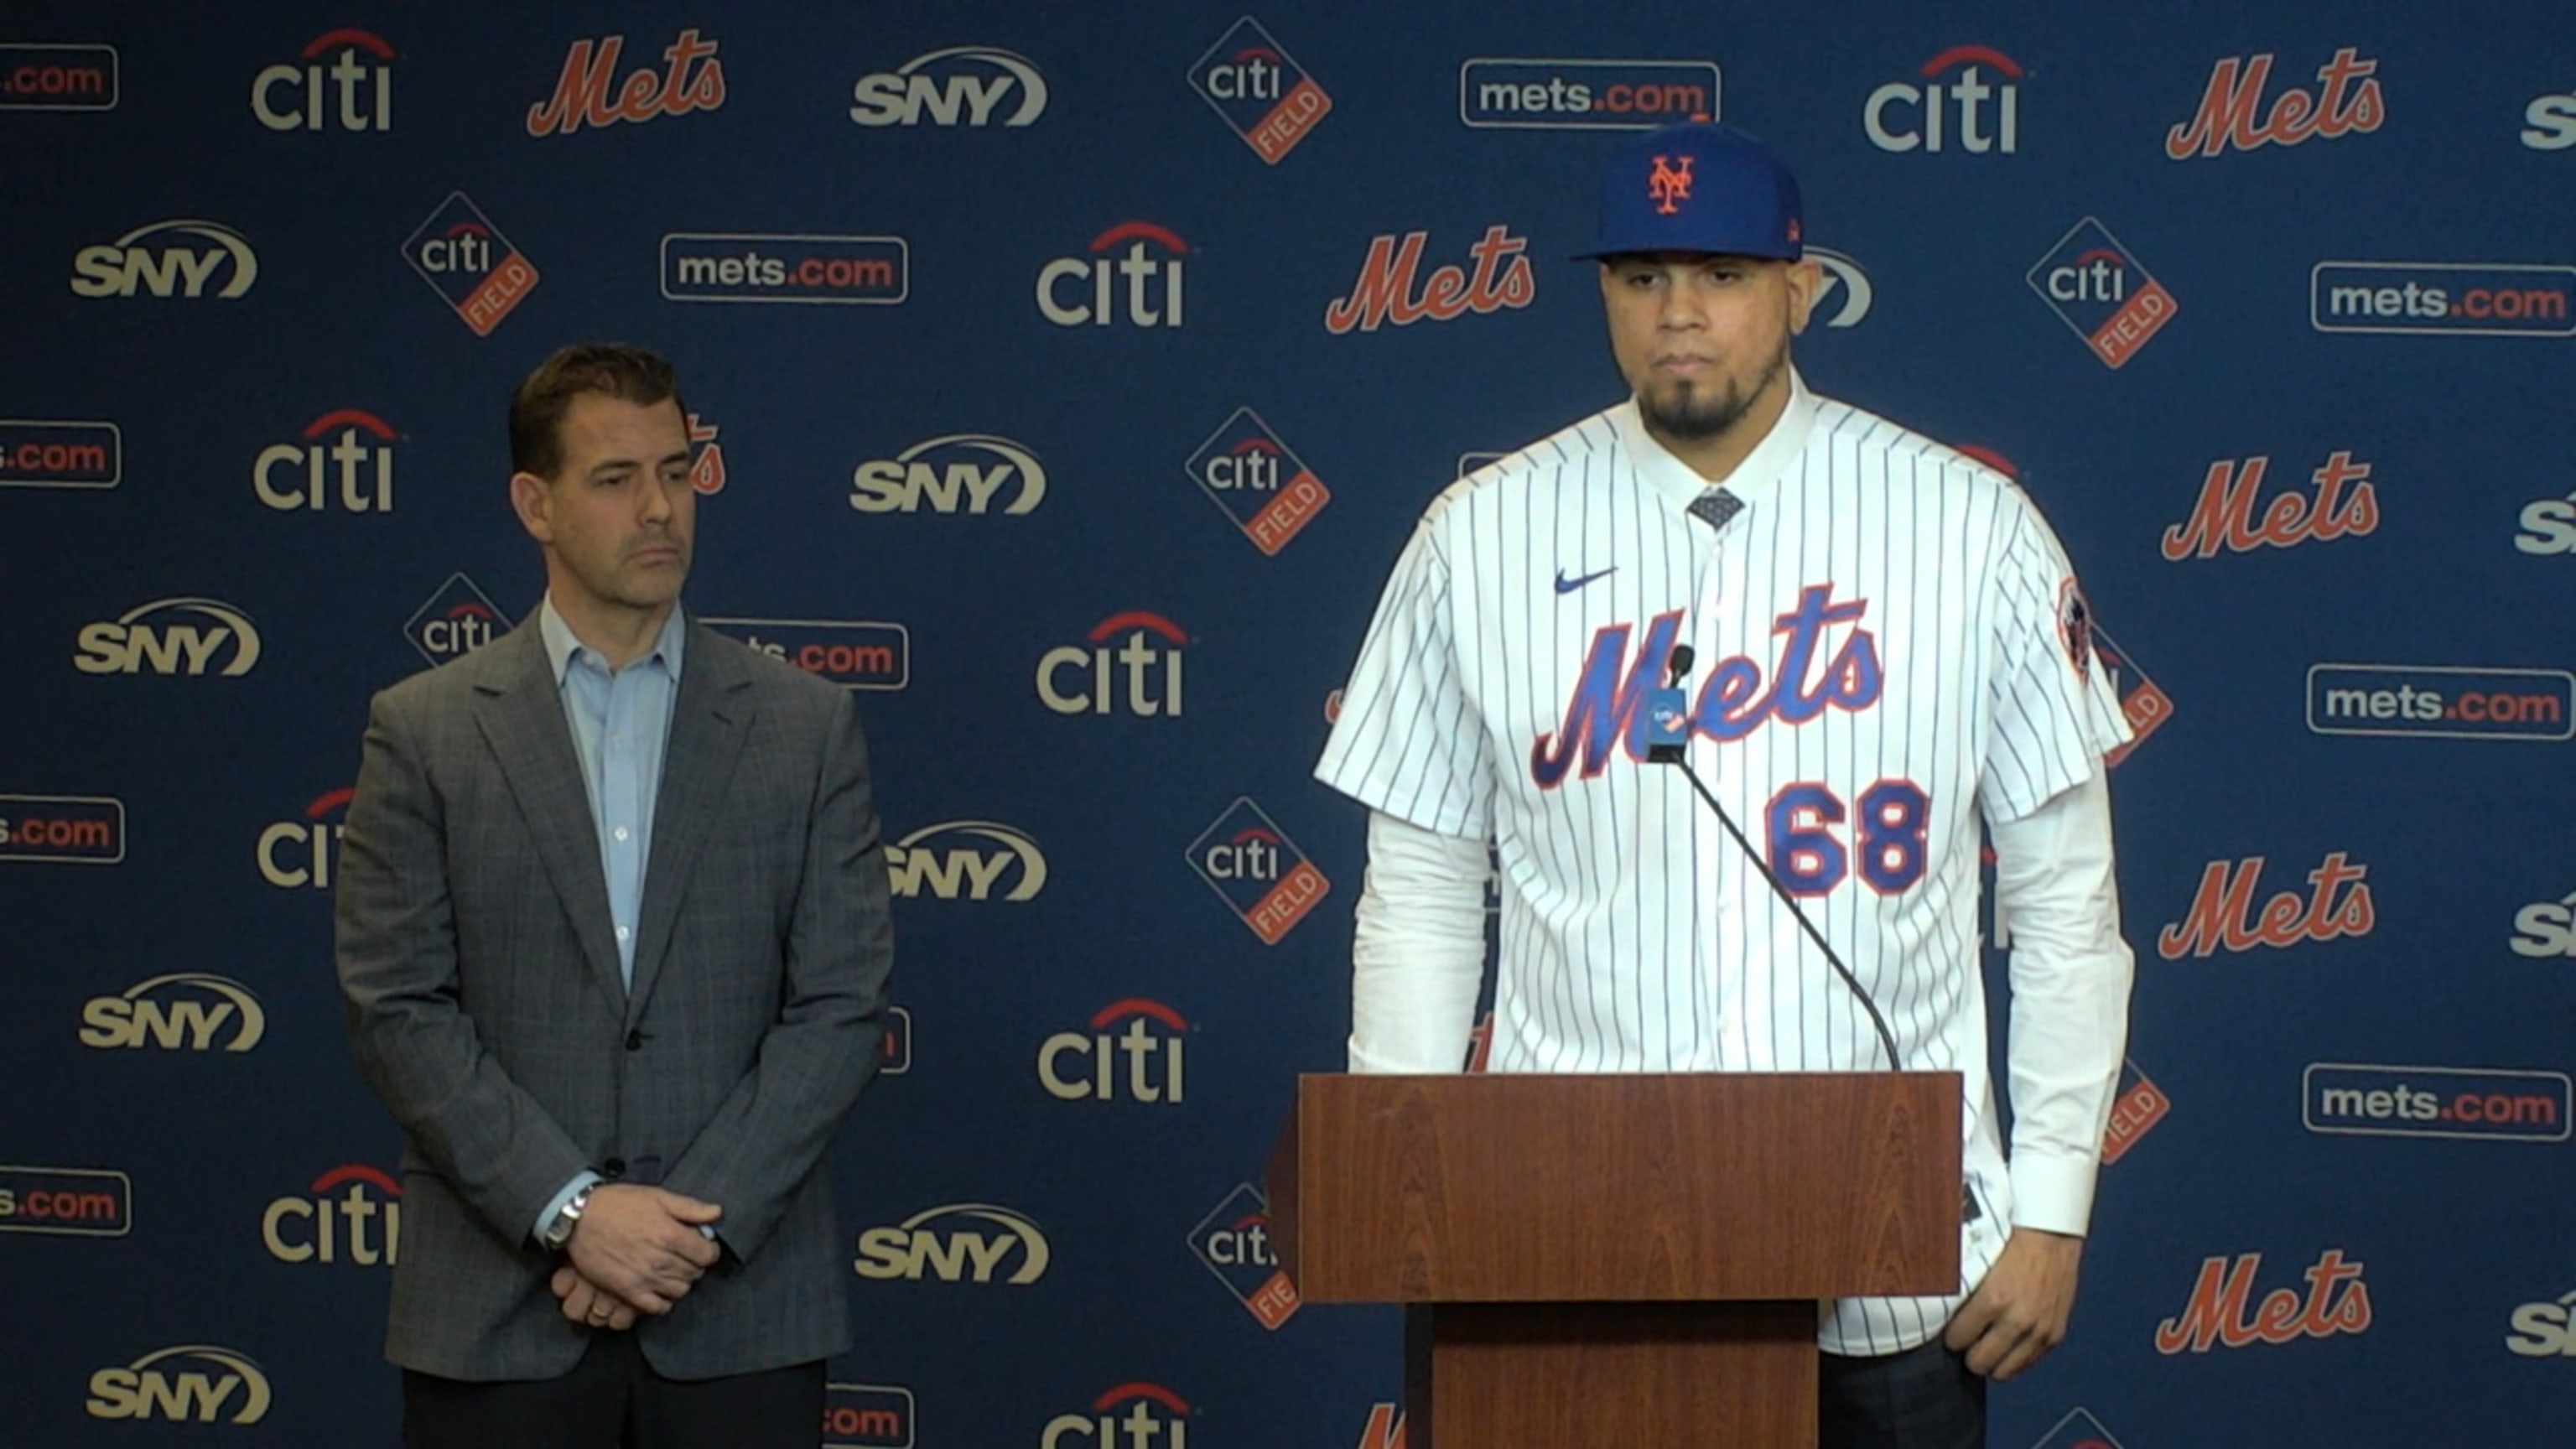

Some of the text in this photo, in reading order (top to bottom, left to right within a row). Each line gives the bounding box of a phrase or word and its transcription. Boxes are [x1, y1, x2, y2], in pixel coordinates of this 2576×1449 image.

[252, 49, 390, 131] citi
[526, 29, 726, 137] Mets
[849, 72, 1015, 127] SNY
[1207, 55, 1280, 100] citi
[1479, 76, 1705, 113] mets.com
[1864, 66, 2016, 153] citi
[2165, 47, 2385, 160] Mets
[1256, 88, 1321, 155] FIELD
[70, 245, 226, 298] SNY
[421, 232, 489, 273] citi
[678, 252, 893, 288] mets.com
[1036, 242, 1182, 327] citi
[1325, 225, 1535, 335] Mets
[2048, 260, 2122, 301] citi
[467, 262, 528, 327] FIELD
[2098, 292, 2166, 359] FIELD
[2330, 281, 2565, 318] mets.com
[253, 428, 392, 512] citi
[849, 459, 1015, 514] SNY
[1207, 449, 1277, 490] citi
[1254, 480, 1319, 547] FIELD
[2161, 450, 2380, 561] Mets
[74, 621, 231, 677] SNY
[423, 612, 491, 653] citi
[1036, 631, 1182, 716] citi
[1531, 583, 1883, 790] Mets
[2326, 683, 2560, 722] mets.com
[257, 822, 345, 888] ci
[1207, 838, 1278, 882] citi
[1764, 778, 1929, 897] 68
[1254, 870, 1319, 936] FIELD
[2158, 851, 2375, 960] Mets
[79, 996, 236, 1051] SNY
[1038, 1018, 1182, 1103] citi
[2101, 1090, 2157, 1156] IELD
[2322, 1083, 2555, 1123] mets.com
[262, 1183, 400, 1265] citi
[854, 1226, 1018, 1283] SNY
[2154, 1249, 2372, 1355] Mets
[86, 1368, 244, 1424] SNY
